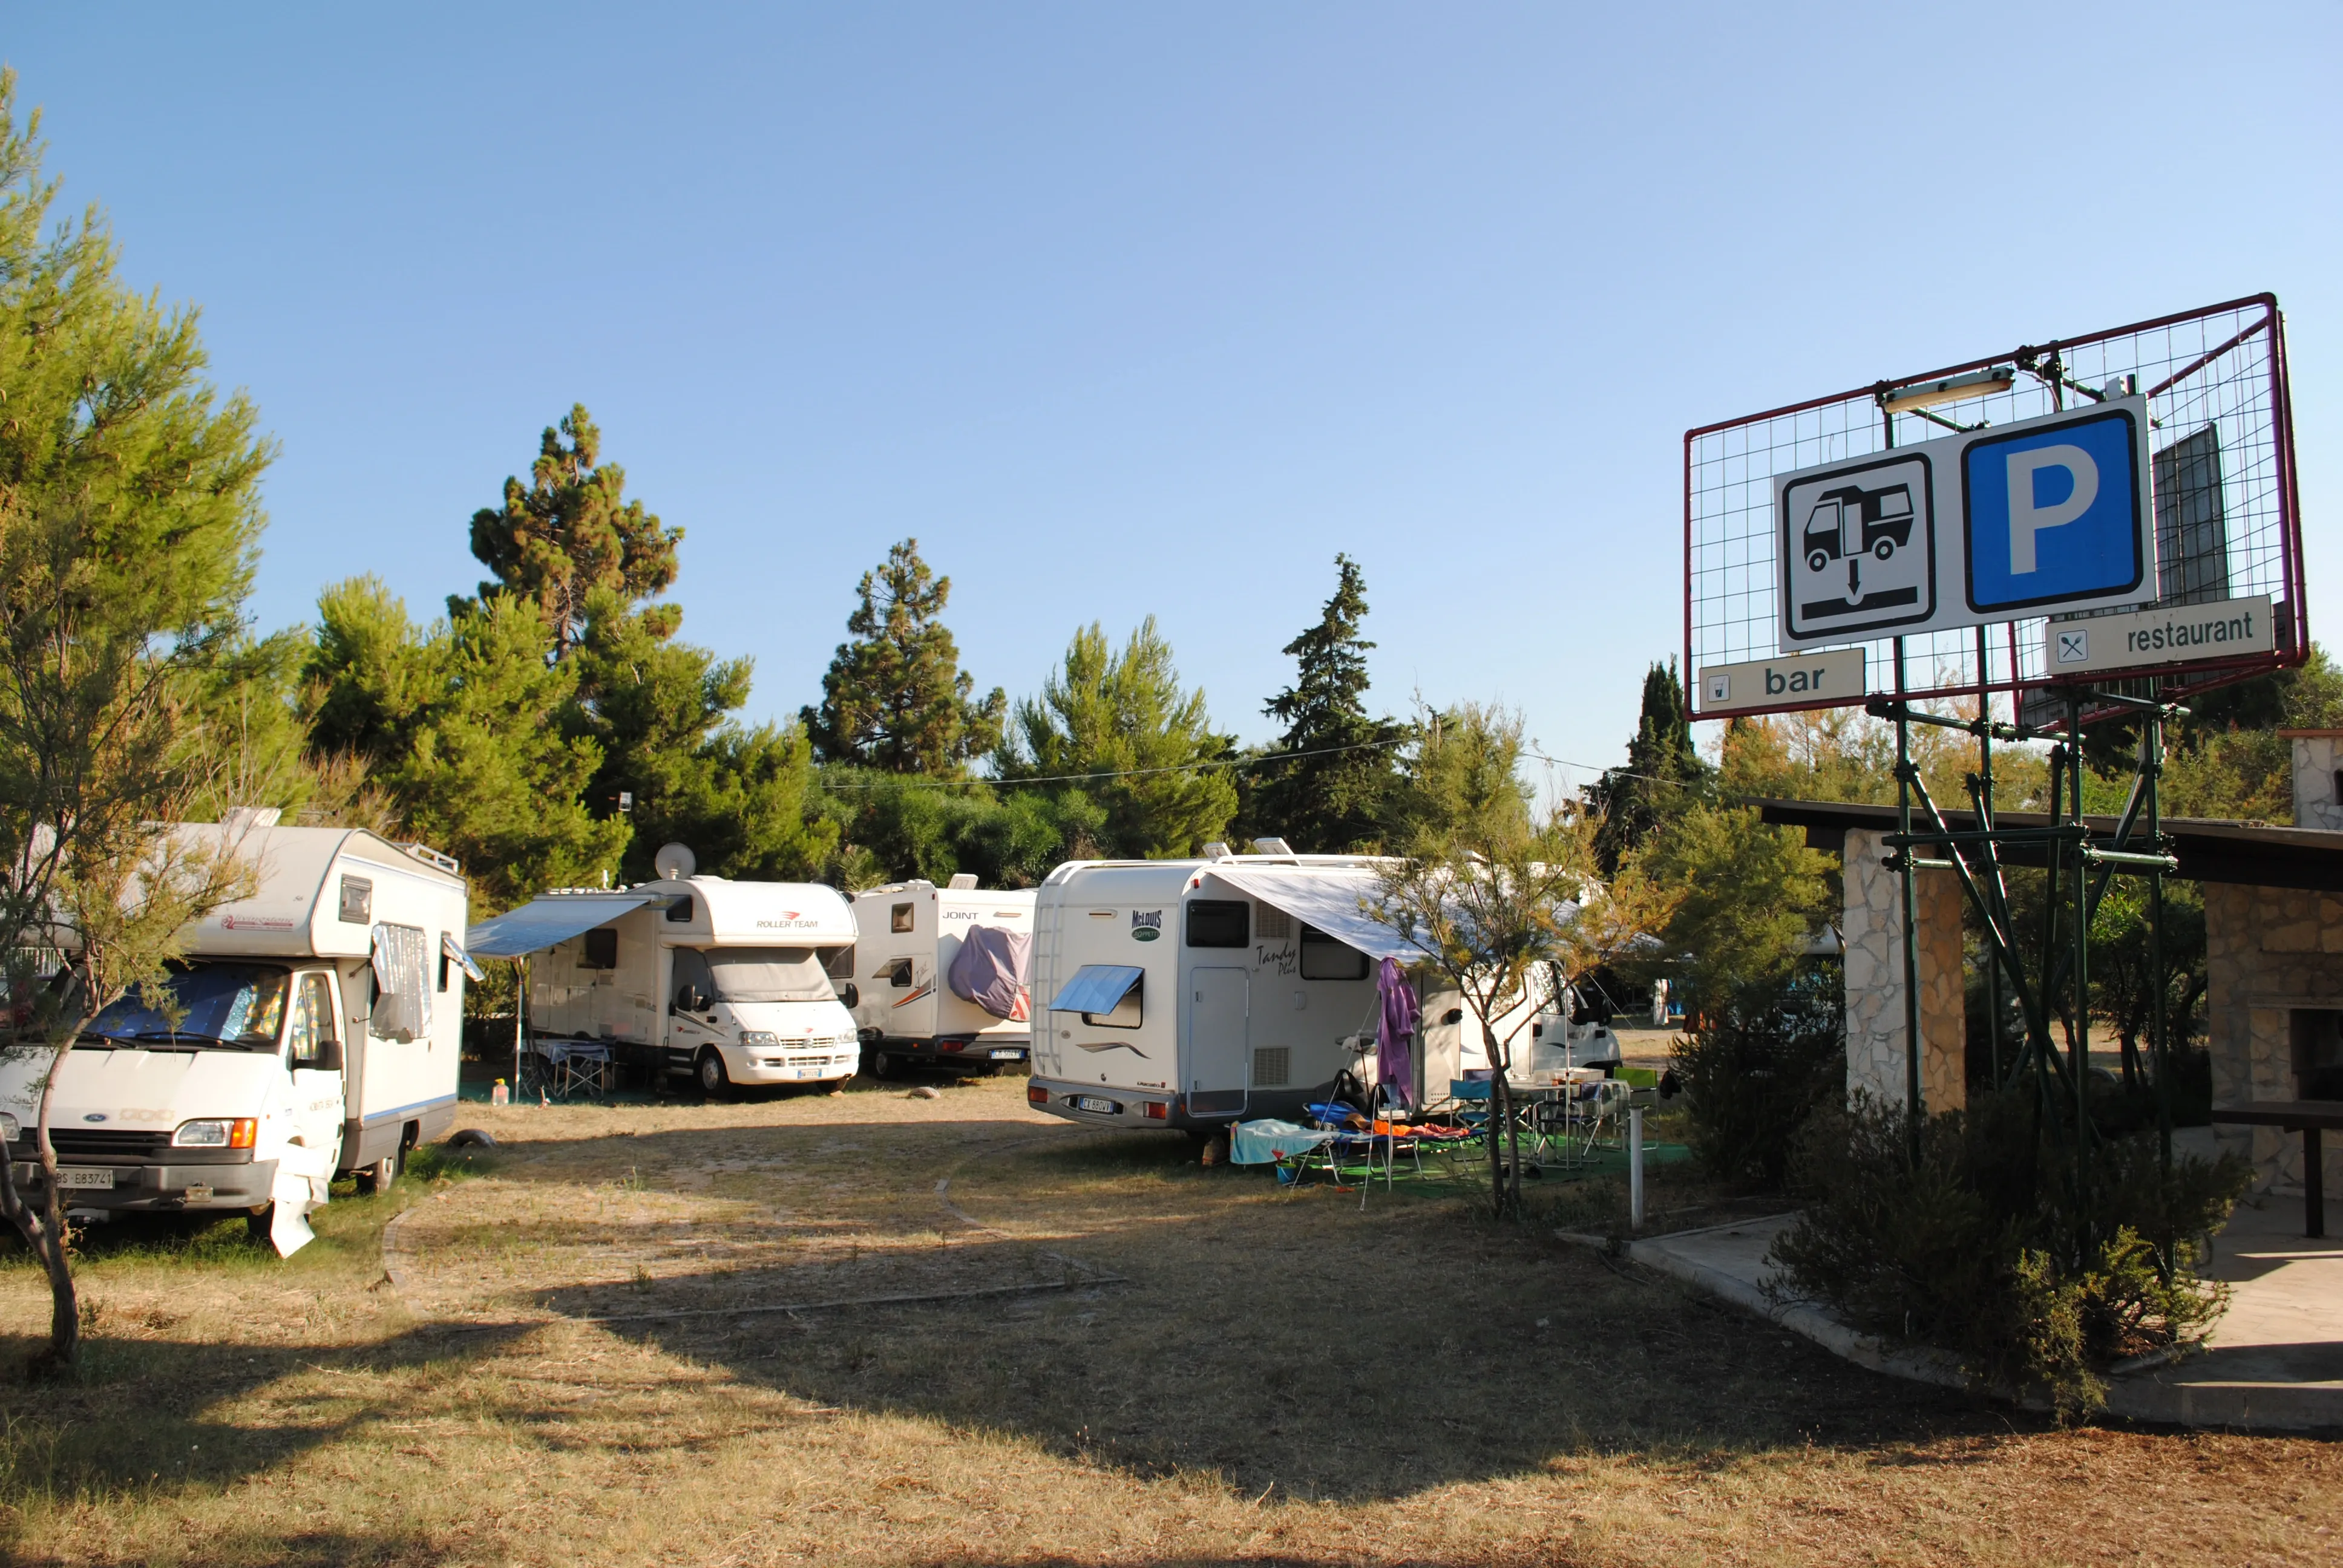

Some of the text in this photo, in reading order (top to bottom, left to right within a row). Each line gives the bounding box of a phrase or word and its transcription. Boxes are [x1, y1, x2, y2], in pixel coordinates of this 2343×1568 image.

[2007, 444, 2099, 575] P
[2128, 612, 2253, 652] restaurant
[1765, 668, 1824, 695] bar
[1256, 941, 1296, 966] Tandy
[1278, 962, 1296, 976] Plus
[75, 1174, 111, 1184] E83741
